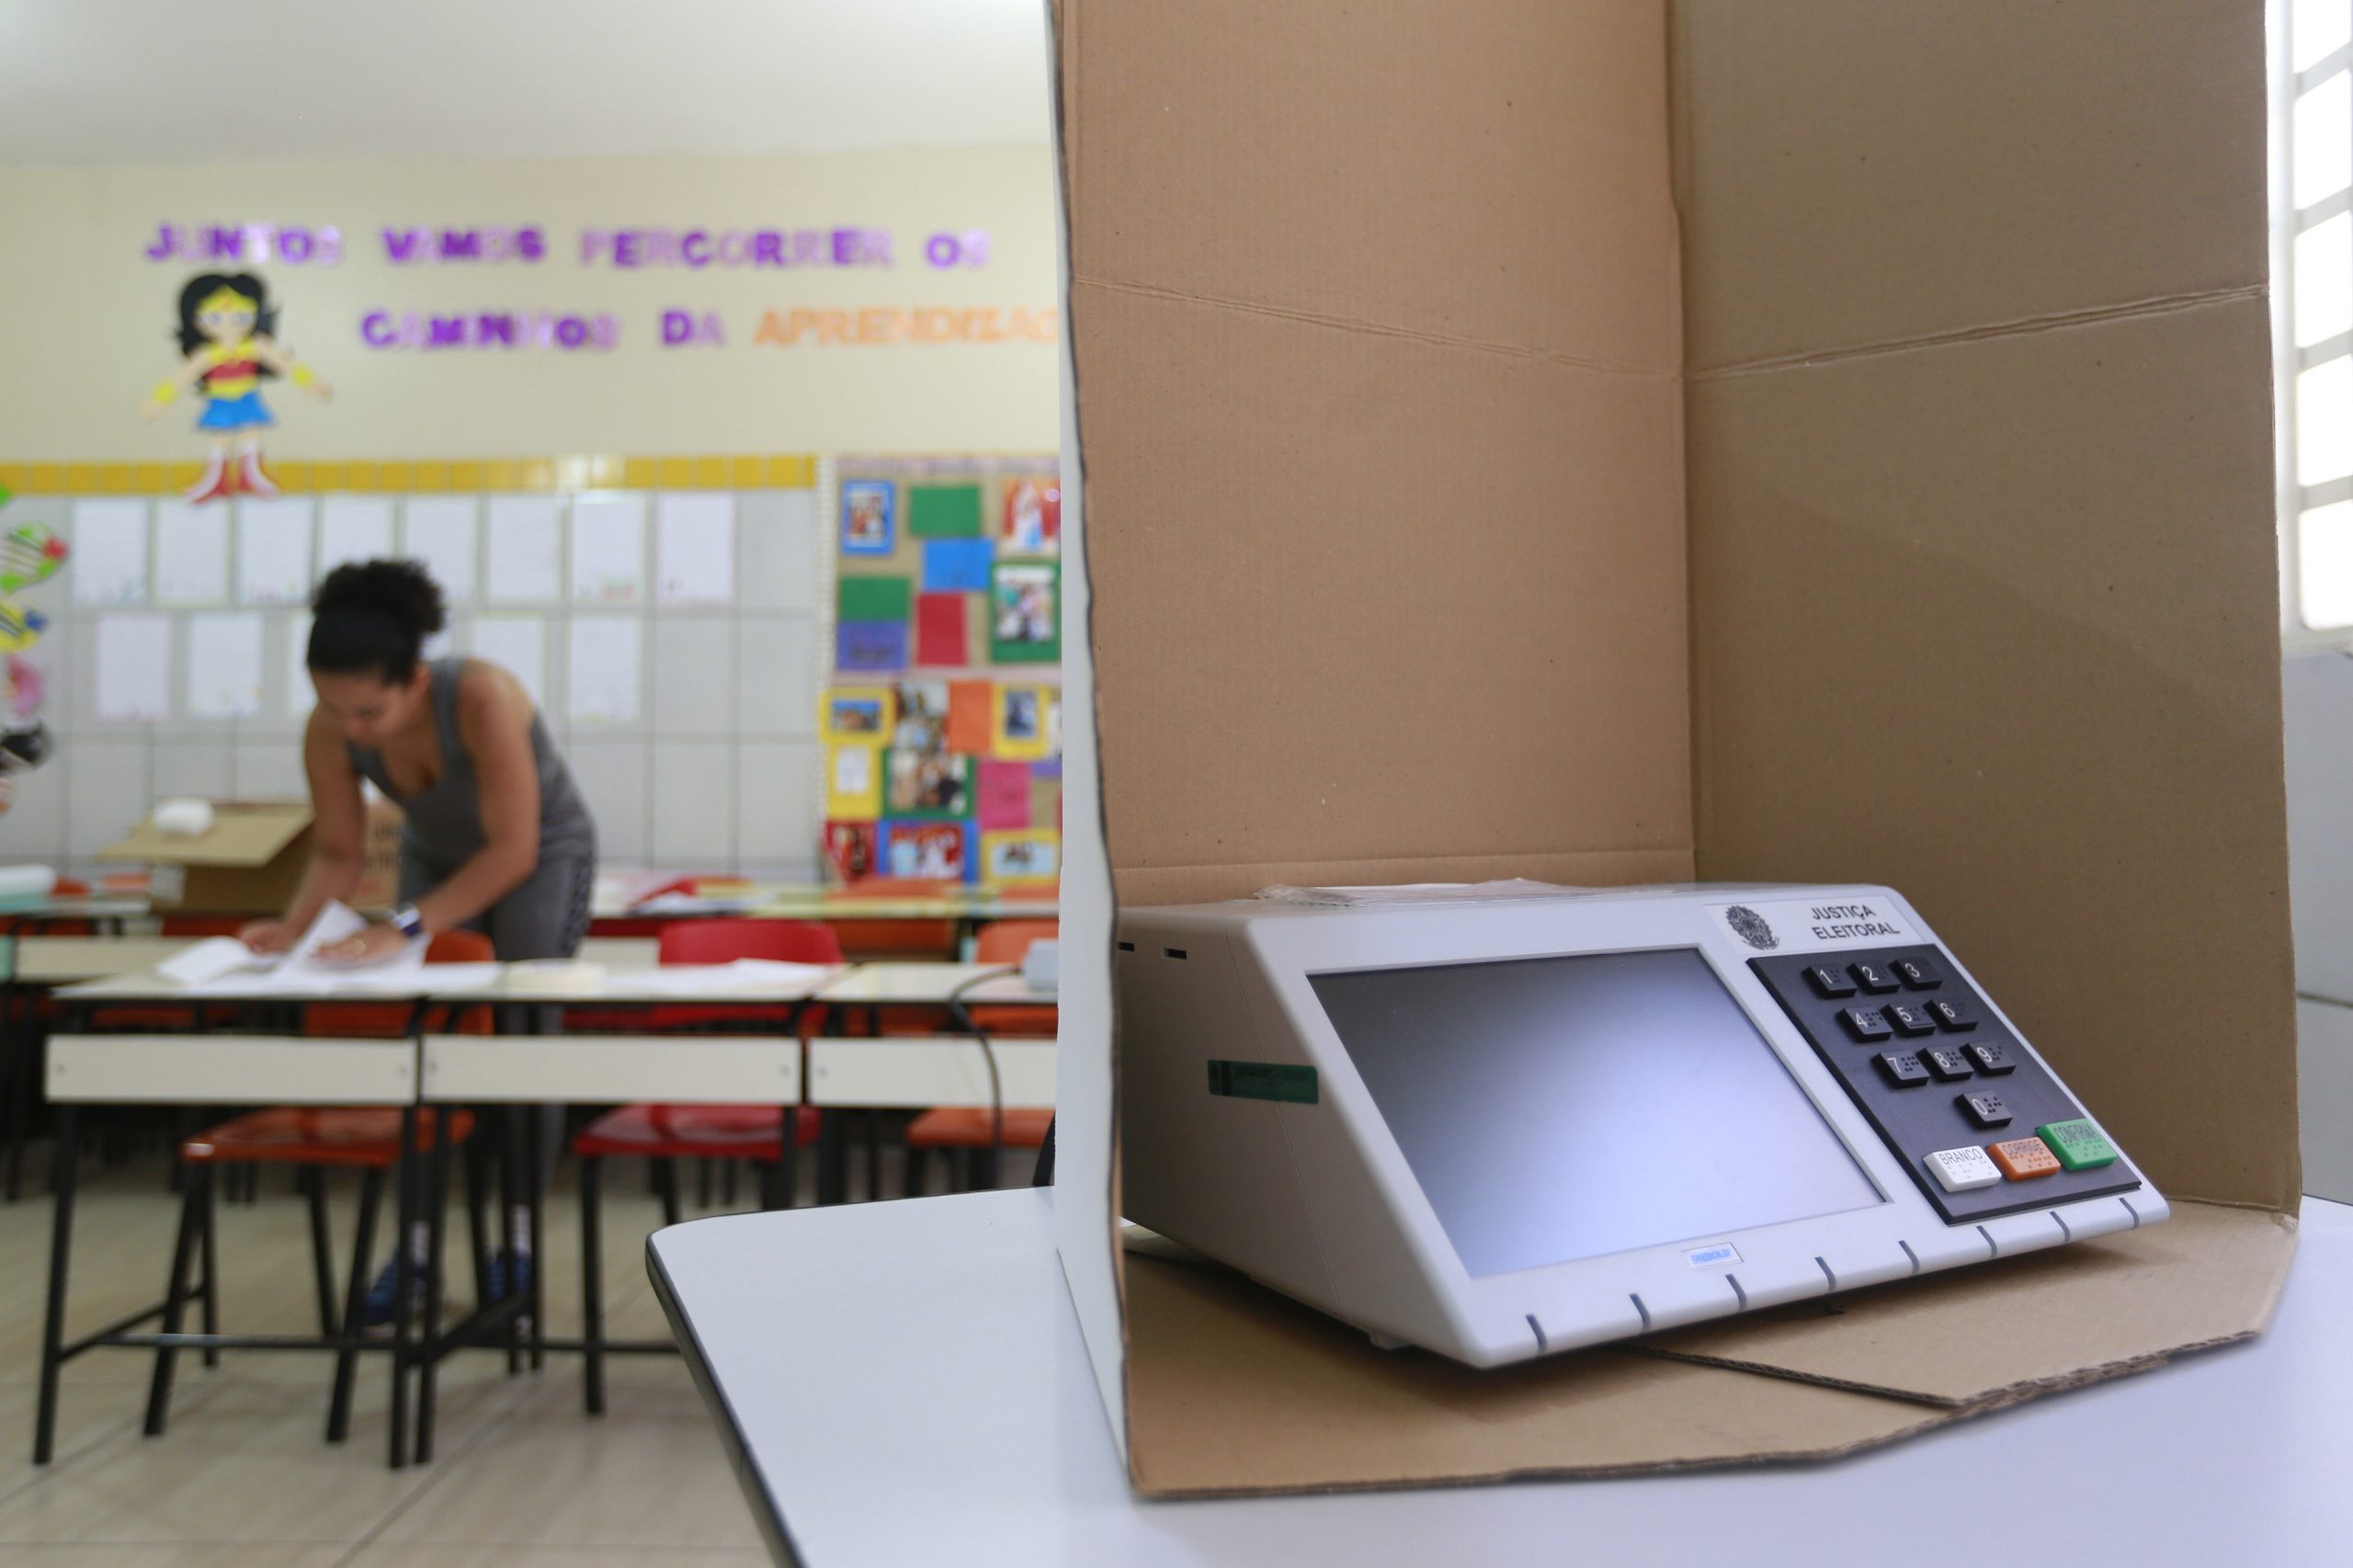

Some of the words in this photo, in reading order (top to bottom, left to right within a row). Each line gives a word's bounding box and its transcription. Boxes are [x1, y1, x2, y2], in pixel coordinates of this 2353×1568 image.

[145, 224, 345, 265] JUNTOS
[382, 227, 548, 263] VAMOS
[581, 230, 894, 267] PERCORRER
[359, 311, 620, 349] CAMINHOS
[661, 310, 726, 347] DA
[1812, 905, 1876, 920] JUSTIÇA
[1812, 922, 1901, 940] ELEITORAL
[1819, 970, 1833, 984] 1
[1861, 966, 1879, 981] 2
[1904, 962, 1921, 978] 3
[1855, 1013, 1869, 1028] 4
[1896, 1006, 1913, 1022] 5
[1939, 1002, 1956, 1017] 6
[1887, 1057, 1902, 1074] 7
[1934, 1051, 1950, 1068] 8
[1976, 1047, 1993, 1062] 9
[1938, 1149, 1984, 1165] BRANCO
